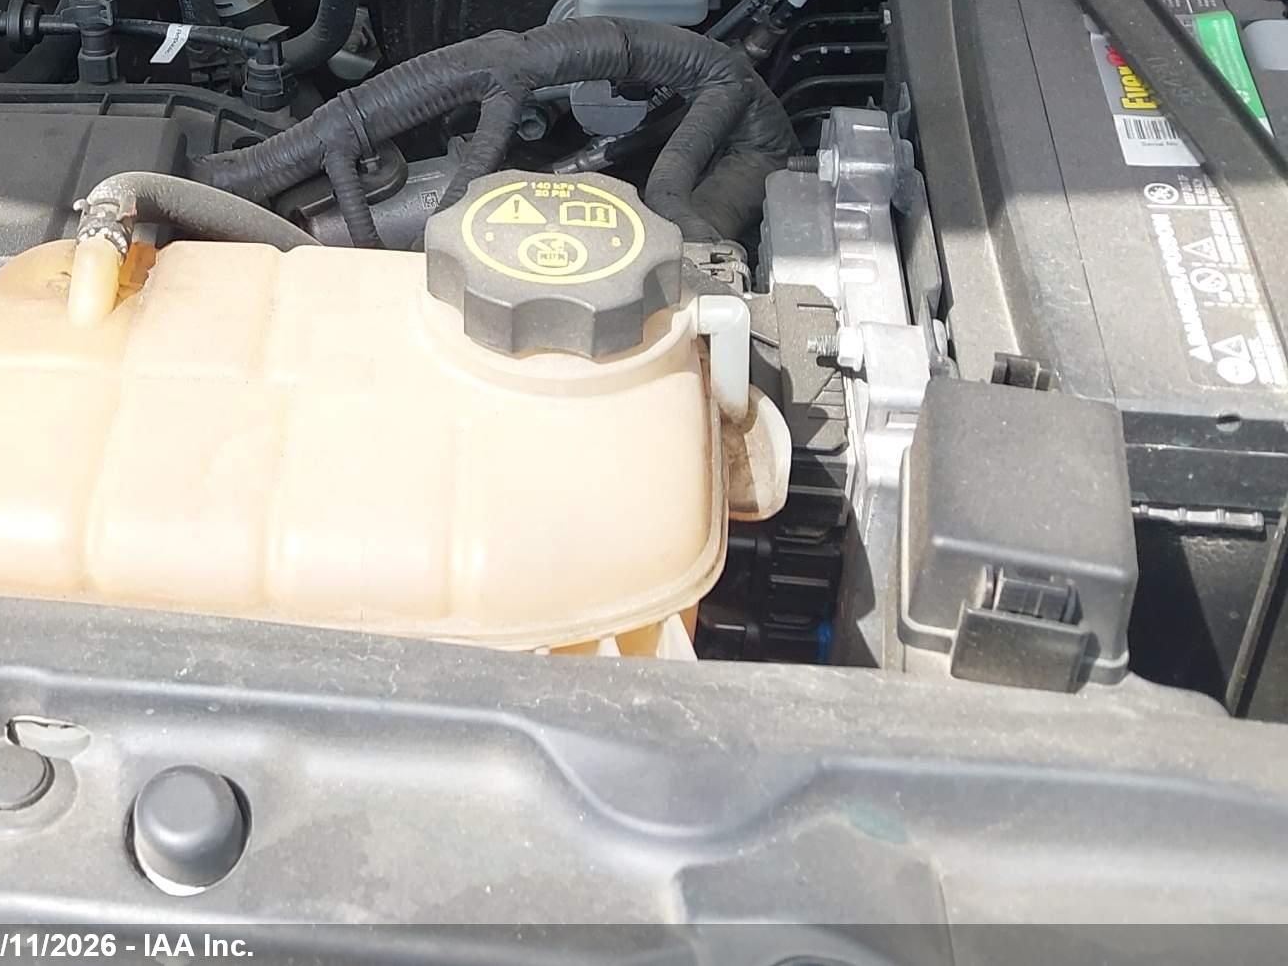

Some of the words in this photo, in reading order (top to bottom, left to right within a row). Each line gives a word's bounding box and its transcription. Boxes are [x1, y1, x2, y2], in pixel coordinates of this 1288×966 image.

[531, 181, 551, 190] 140
[553, 182, 575, 191] kPa
[534, 189, 550, 197] 20
